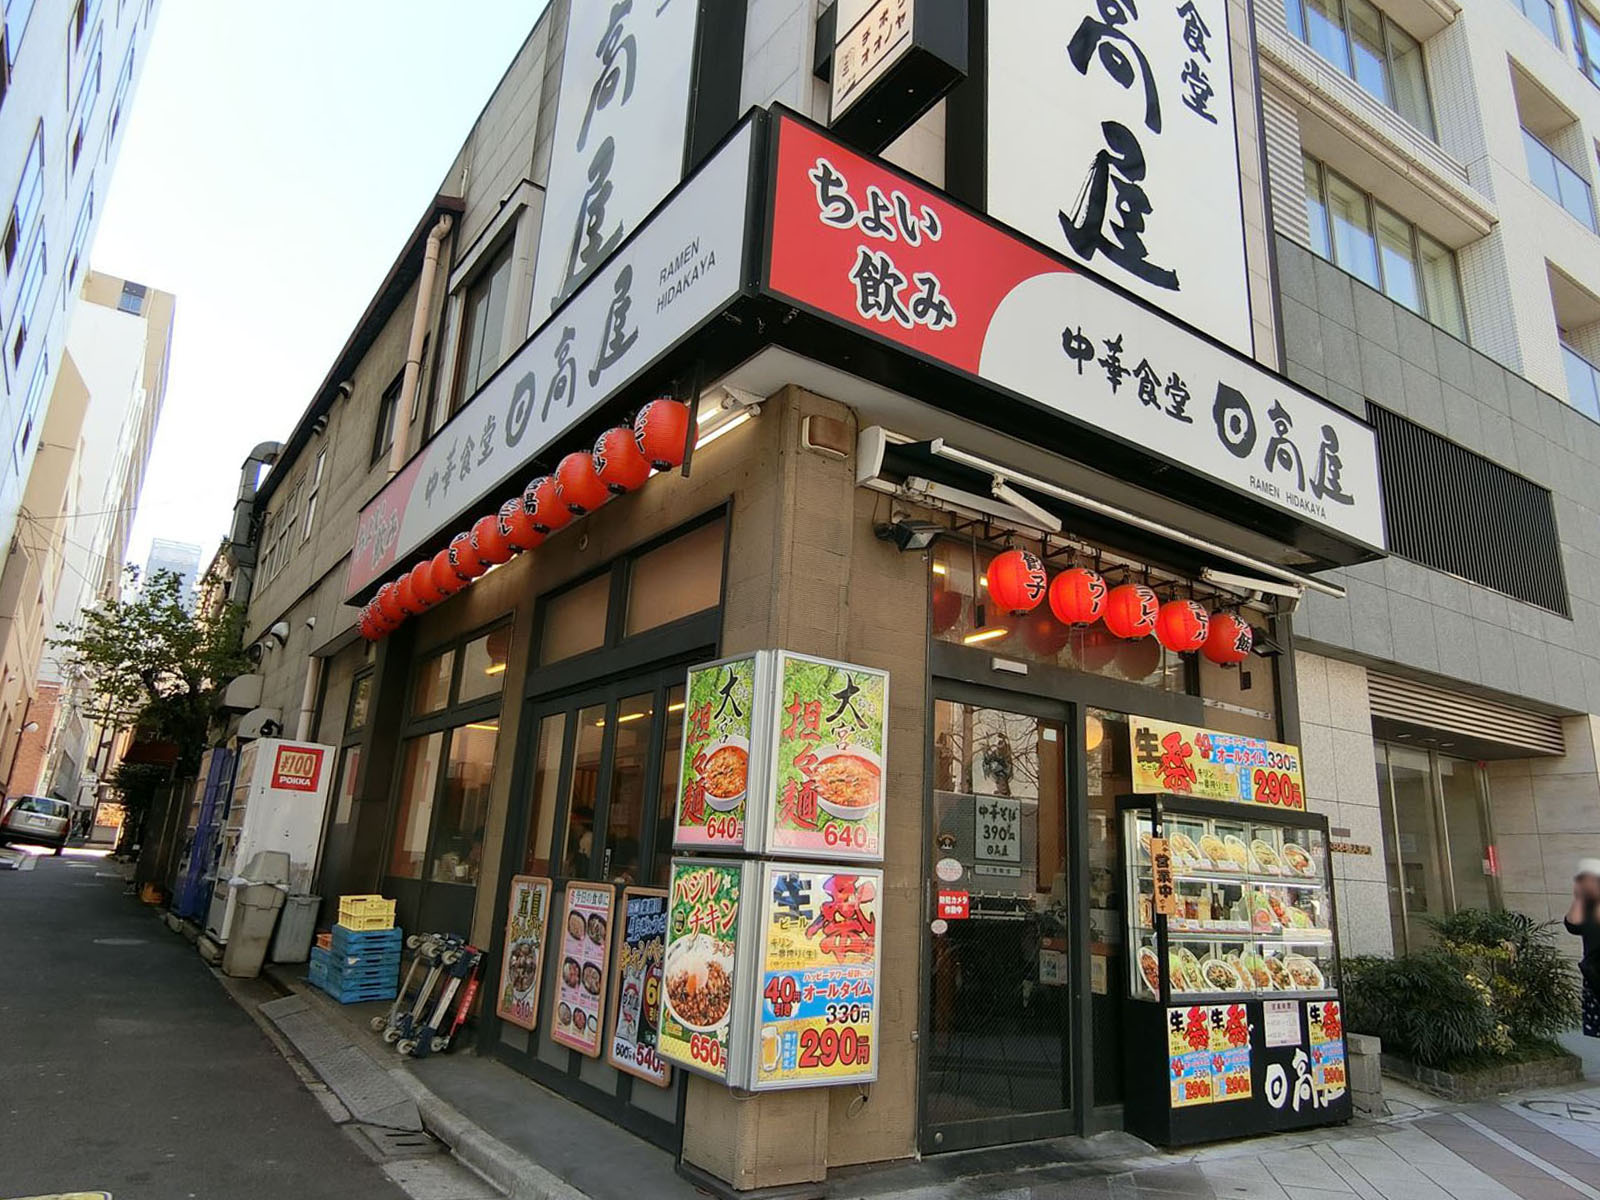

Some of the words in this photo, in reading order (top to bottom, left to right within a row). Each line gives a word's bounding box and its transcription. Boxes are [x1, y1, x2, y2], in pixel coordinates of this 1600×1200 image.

[809, 157, 942, 247] ちょい
[659, 237, 700, 285] RAMEN
[656, 250, 716, 315] HIDAKAYA
[848, 244, 957, 331] 飲み
[1061, 325, 1194, 424] 中華食堂
[1212, 379, 1355, 506] 日高屋
[425, 414, 496, 509] 中華食堂
[1249, 474, 1281, 500] RAMEN
[1285, 491, 1327, 520] HIDAKAYA
[714, 666, 743, 744] 大宮
[826, 672, 869, 750] 大宮
[1136, 727, 1162, 763] 生
[1217, 748, 1266, 766] オールタイム
[279, 775, 312, 787] POKKA
[1253, 768, 1303, 809] 290円
[979, 802, 1018, 822] 中華そば
[824, 823, 877, 849] 640円
[673, 869, 722, 909] バジル
[1155, 853, 1173, 898] 営業中
[774, 872, 813, 923] 生
[688, 900, 739, 950] チキン
[770, 937, 794, 951] キリン
[780, 918, 808, 930] ビール
[803, 980, 873, 1002] オールタイム
[826, 1003, 870, 1024] 330円
[690, 1033, 728, 1071] 650円
[798, 1026, 870, 1068] 290円
